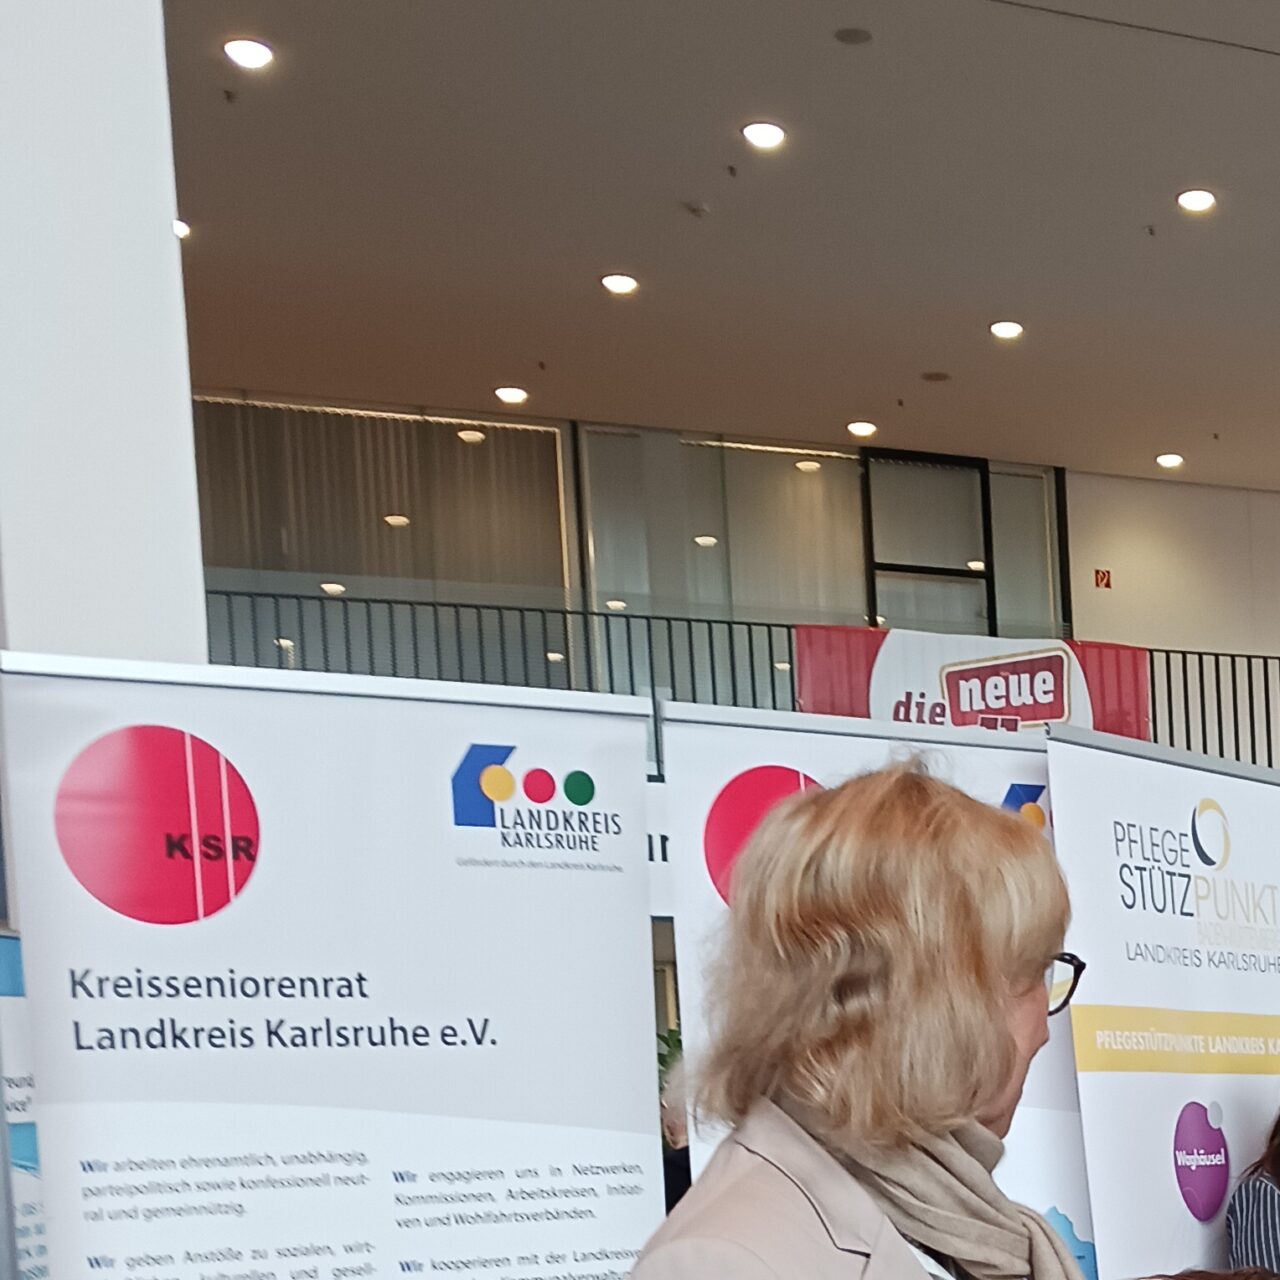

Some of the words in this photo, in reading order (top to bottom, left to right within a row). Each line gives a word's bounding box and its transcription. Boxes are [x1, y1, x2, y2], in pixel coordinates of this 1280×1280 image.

[893, 691, 946, 726] die
[958, 670, 1055, 713] neue
[500, 808, 622, 835] LANDKREIS
[165, 833, 256, 862] KSR
[501, 832, 600, 852] KARLSRUHE
[1113, 821, 1190, 868] PFLEGE
[1125, 941, 1202, 967] LANDKREIS
[69, 967, 368, 1000] Kreisseniorenrat
[73, 1018, 255, 1051] Landkreis
[266, 1017, 431, 1049] Karlsruhe
[440, 1018, 497, 1047] e.V.
[1096, 1028, 1205, 1053] PFLEGESTÜTZPUNKTE
[1208, 1036, 1265, 1054] LANDKREIS
[80, 1159, 108, 1173] Wir
[1176, 1148, 1225, 1170] Waghäusel
[392, 1170, 418, 1183] Wir
[106, 1207, 139, 1221] und
[424, 1214, 451, 1228] und
[87, 1255, 116, 1269] Wir
[124, 1253, 174, 1271] geben
[289, 1266, 318, 1280] und
[400, 1259, 424, 1273] Wir
[545, 1251, 567, 1265] der
